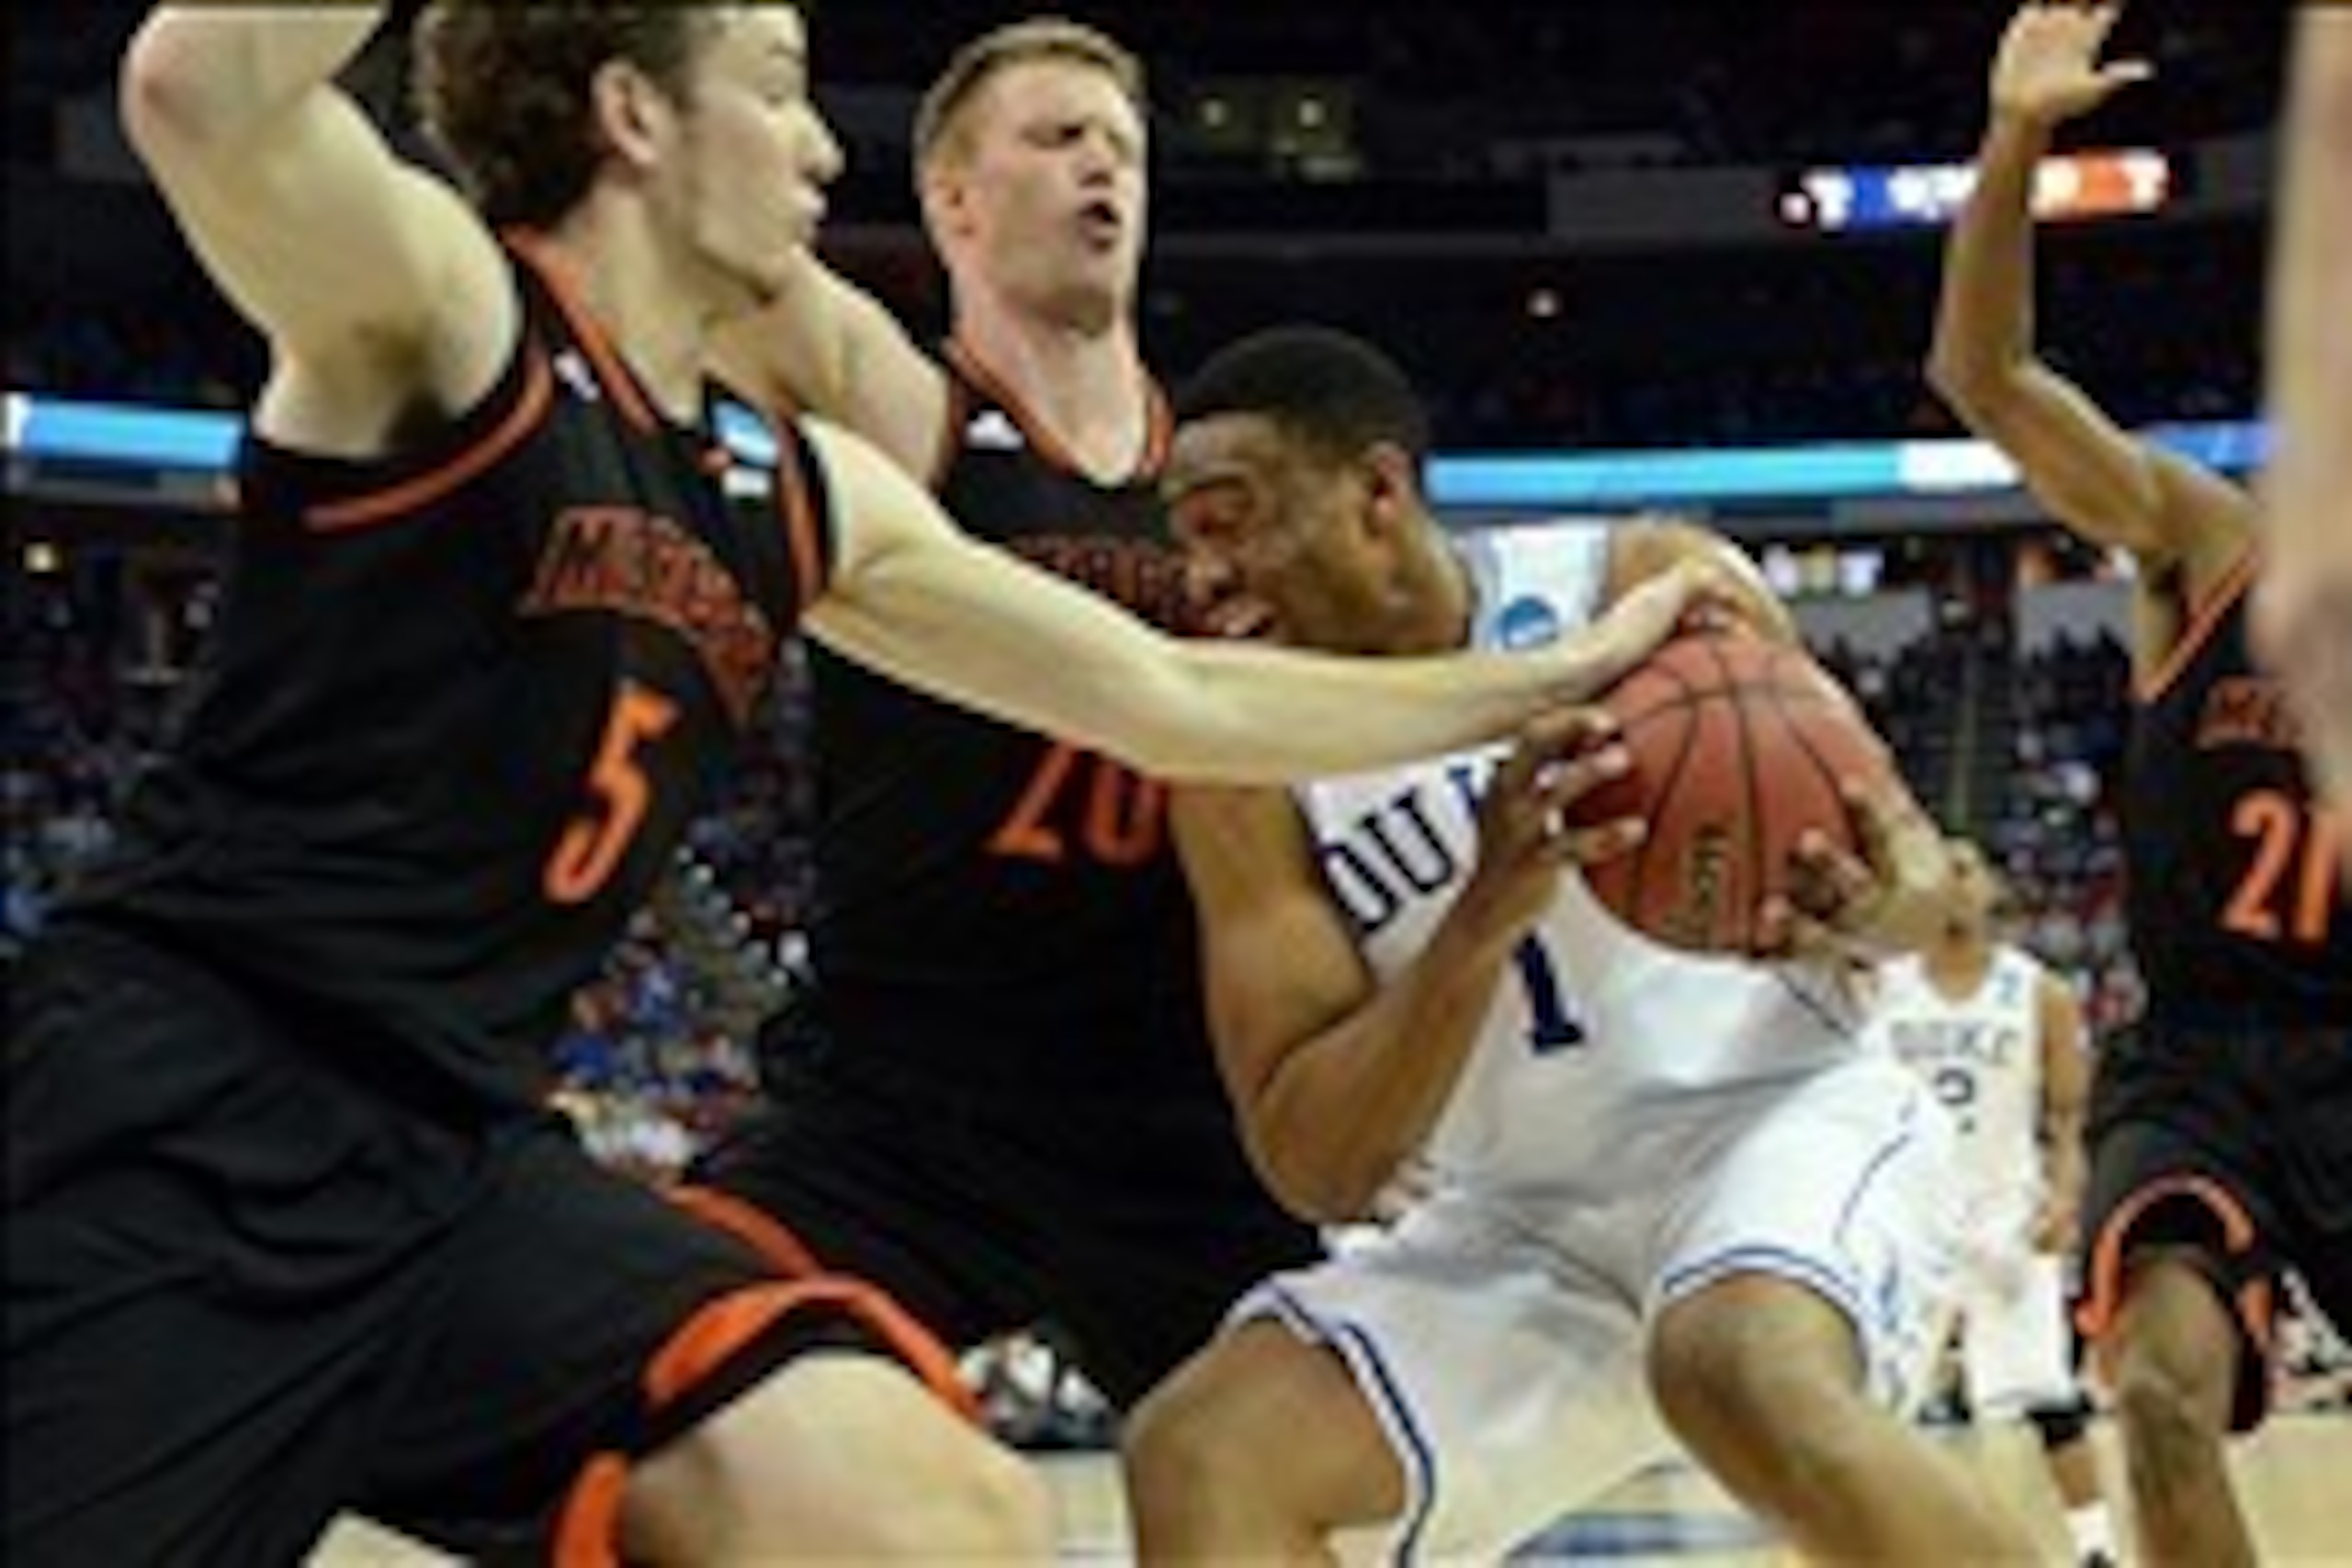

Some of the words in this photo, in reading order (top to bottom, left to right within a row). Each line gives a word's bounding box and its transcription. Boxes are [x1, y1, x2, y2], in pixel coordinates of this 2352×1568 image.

[545, 678, 678, 906] 5
[989, 735, 1169, 866] 20
[2221, 787, 2335, 942] 21
[1512, 930, 1582, 1052] 1
